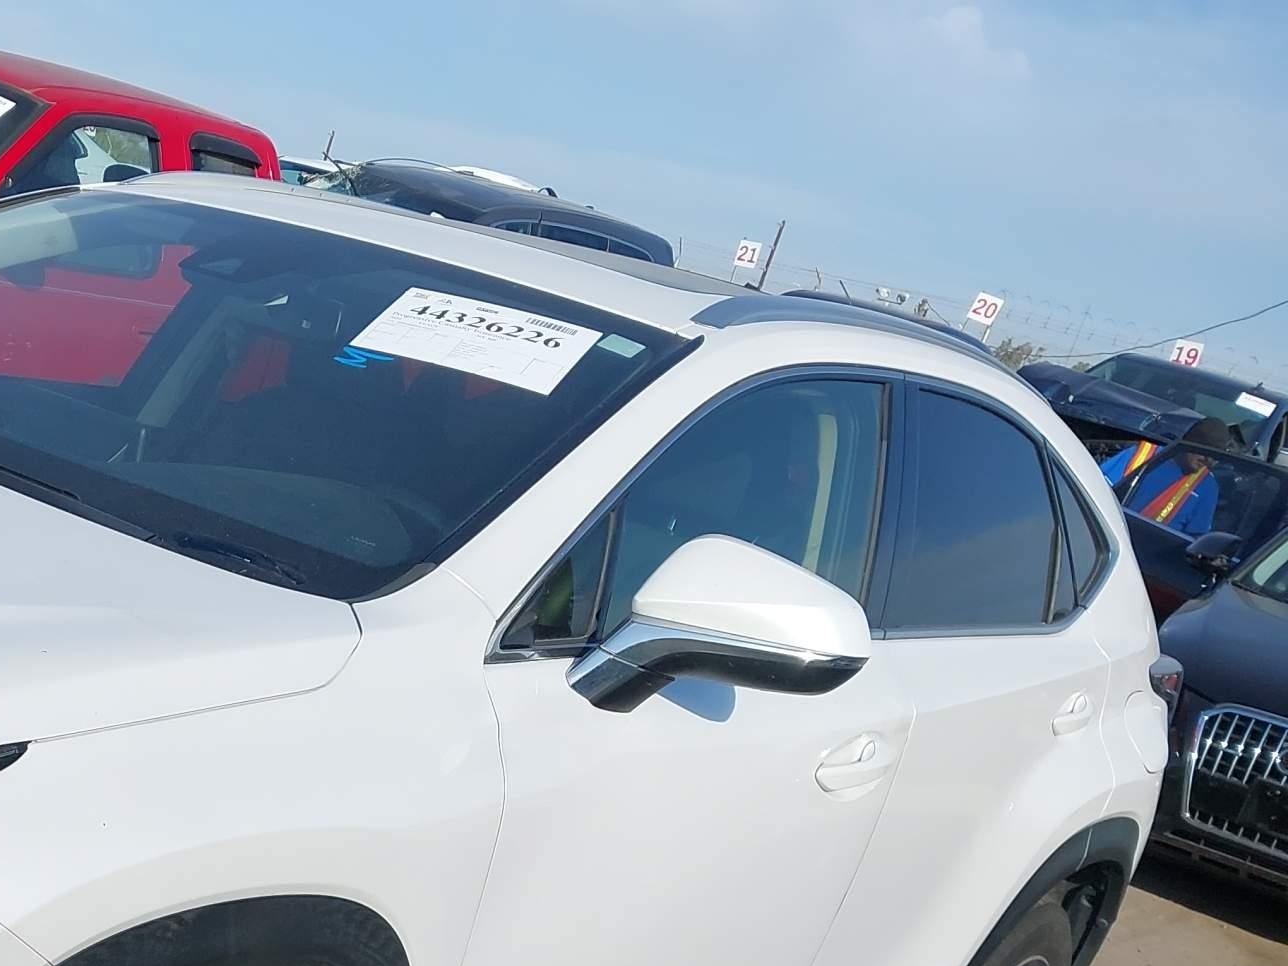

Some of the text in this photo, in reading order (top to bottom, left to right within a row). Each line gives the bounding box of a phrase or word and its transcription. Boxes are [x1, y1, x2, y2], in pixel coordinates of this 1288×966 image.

[737, 245, 757, 264] 21
[972, 298, 998, 318] 20
[410, 305, 563, 349] 44326226
[1172, 346, 1199, 366] 19
